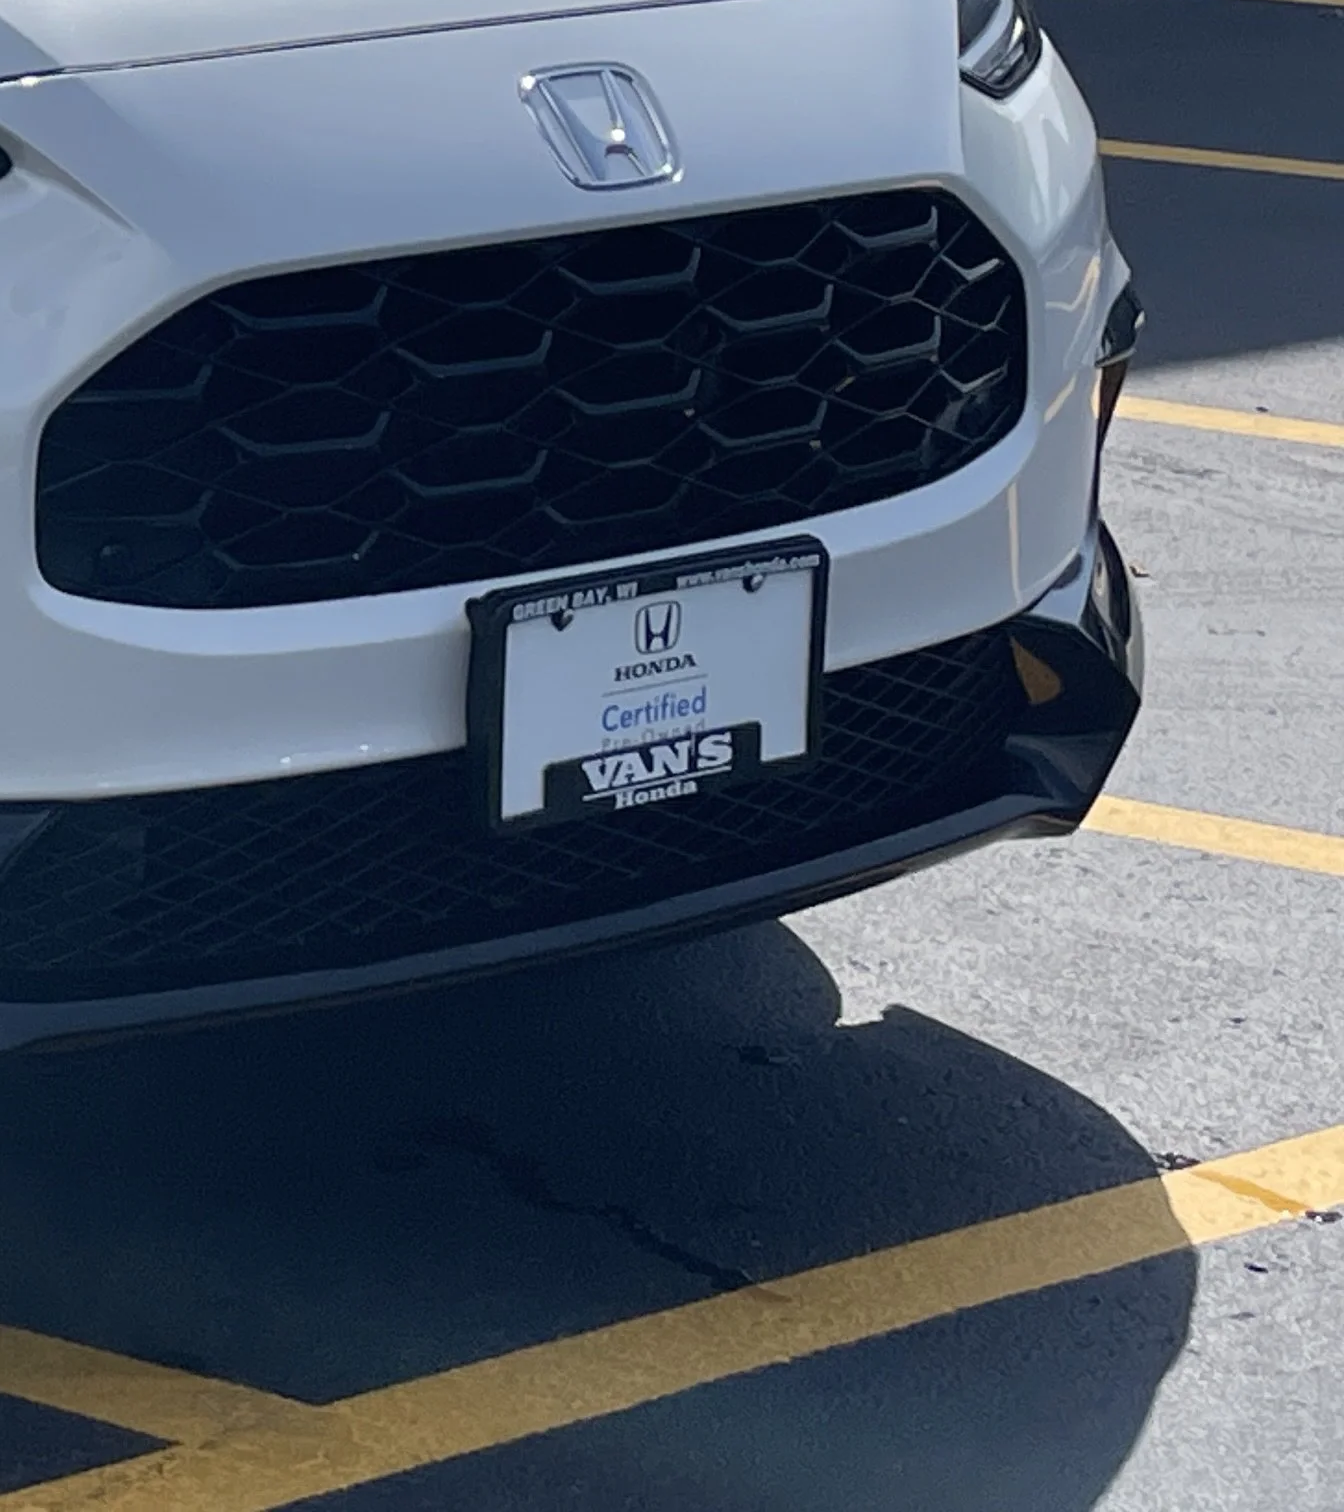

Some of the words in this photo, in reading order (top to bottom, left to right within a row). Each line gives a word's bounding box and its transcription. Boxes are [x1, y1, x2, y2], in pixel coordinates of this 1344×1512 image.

[513, 594, 569, 621] GREEN
[616, 581, 639, 599] WI
[614, 653, 697, 682] HONDA
[601, 685, 707, 732] Certified
[614, 779, 698, 810] Honda
